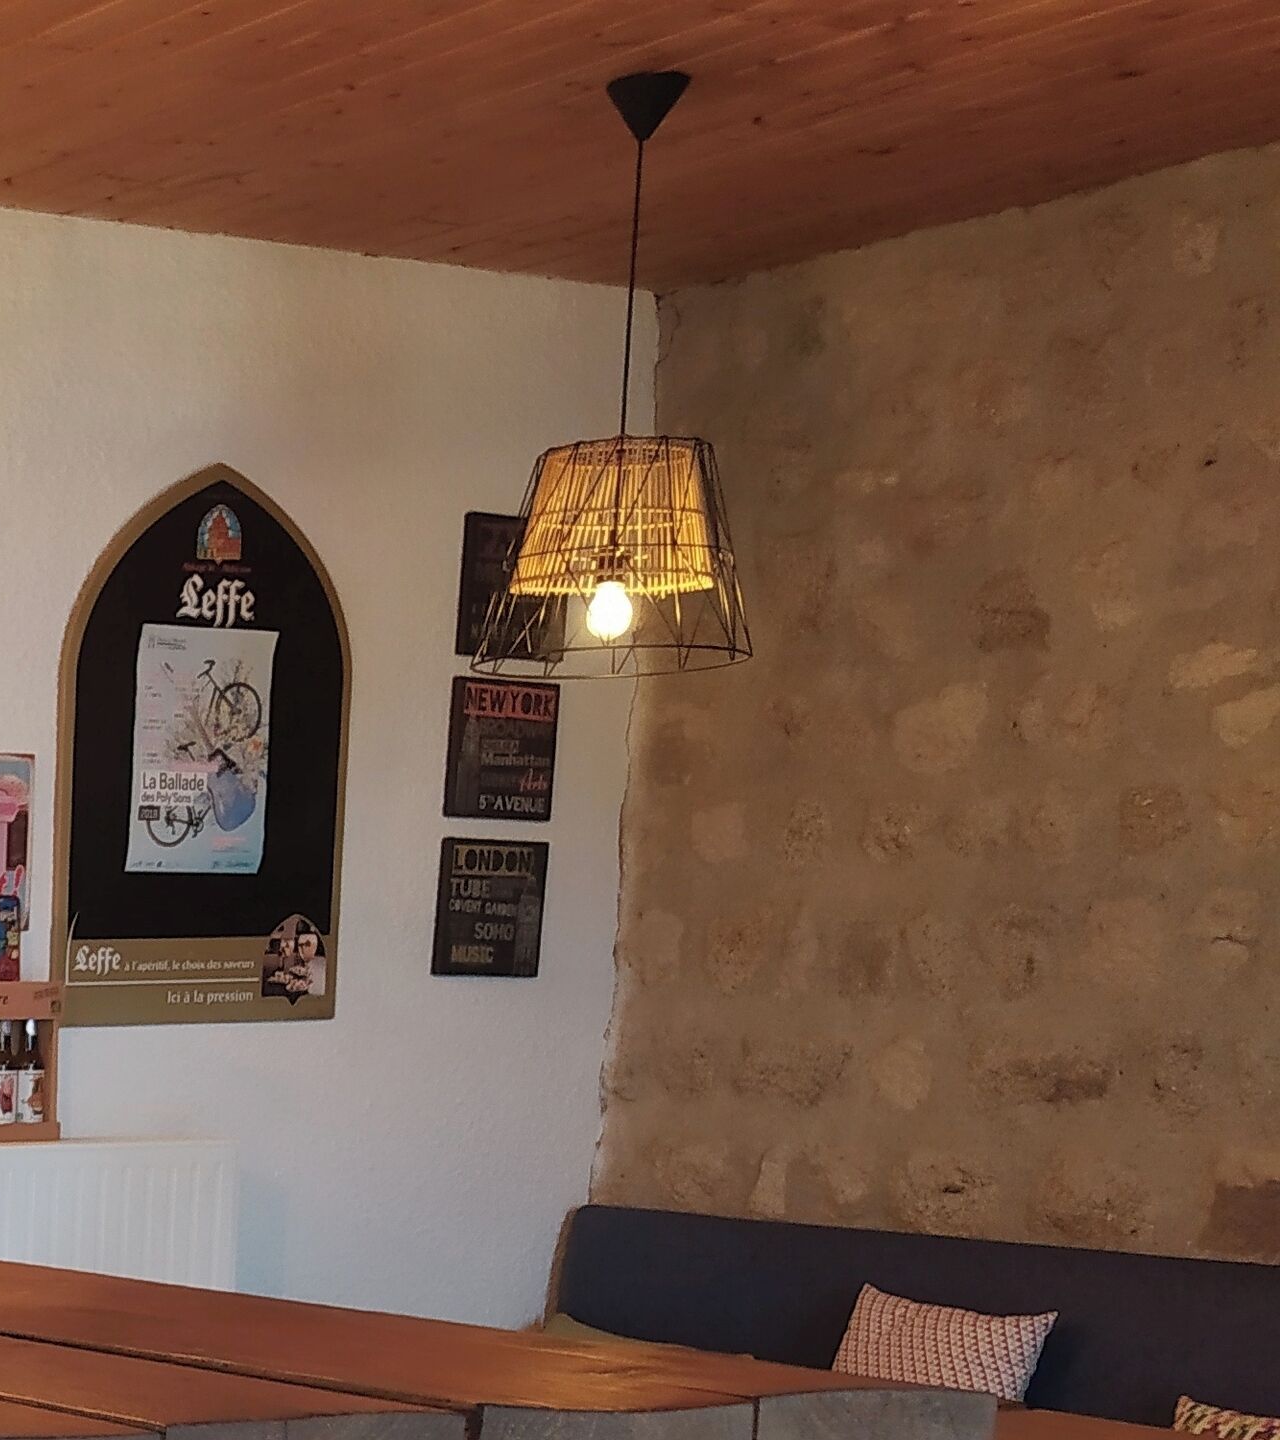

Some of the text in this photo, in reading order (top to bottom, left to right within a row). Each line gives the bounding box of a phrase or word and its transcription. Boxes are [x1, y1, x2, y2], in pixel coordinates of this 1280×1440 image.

[175, 573, 256, 628] Leffe
[142, 771, 204, 791] La Ballade
[454, 847, 533, 873] LONDON
[450, 878, 490, 898] TUBE
[72, 945, 121, 976] Leffe
[167, 989, 254, 1005] Ici à la pression
